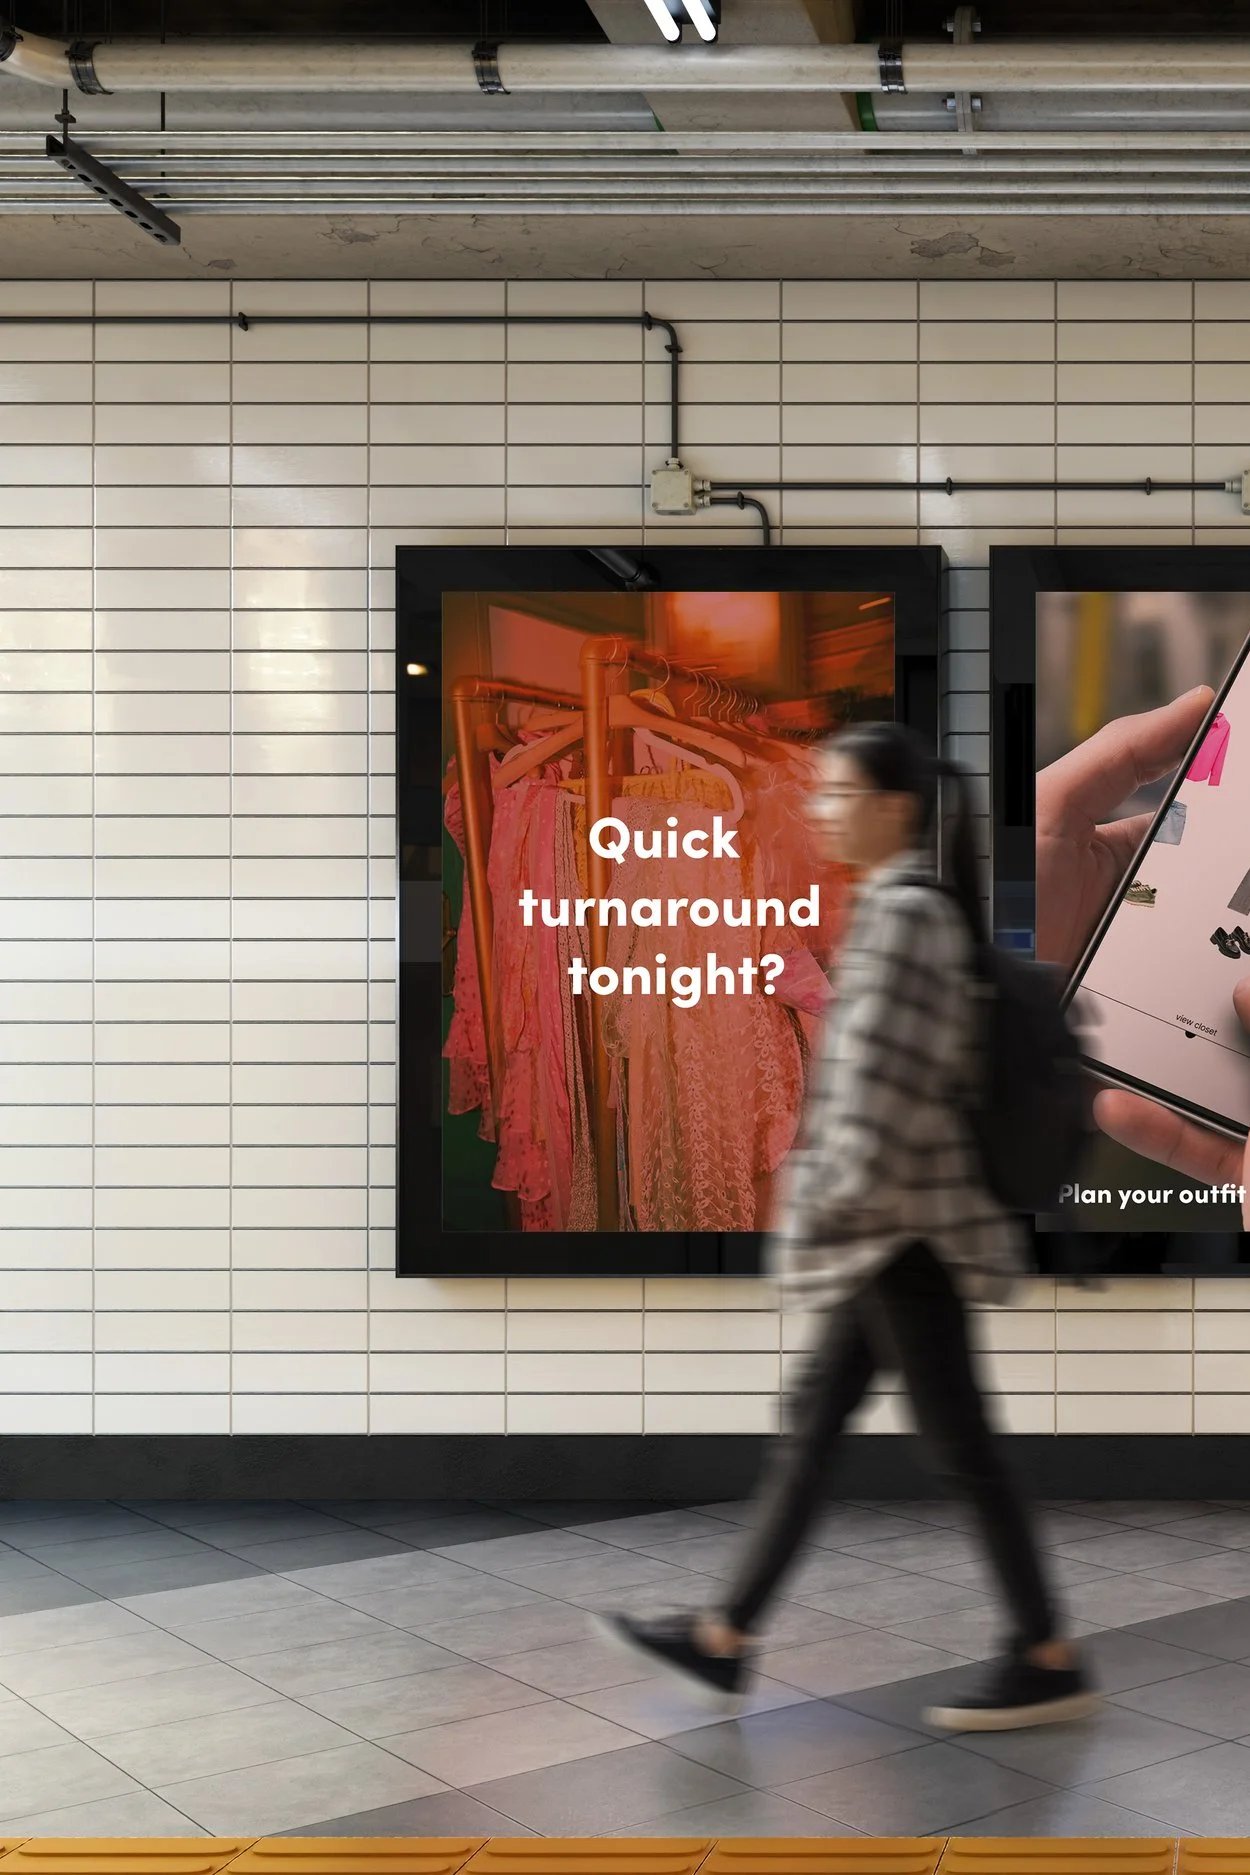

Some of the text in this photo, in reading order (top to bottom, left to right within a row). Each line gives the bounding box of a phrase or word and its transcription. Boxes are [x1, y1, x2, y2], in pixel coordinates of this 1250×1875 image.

[589, 816, 741, 865] Quick
[518, 885, 821, 928] turnaround
[567, 952, 785, 1009] tonight?
[1176, 1014, 1218, 1036] view closet
[1058, 1183, 1112, 1204] Plan
[1118, 1189, 1174, 1210] your
[1179, 1183, 1247, 1204] outfit
